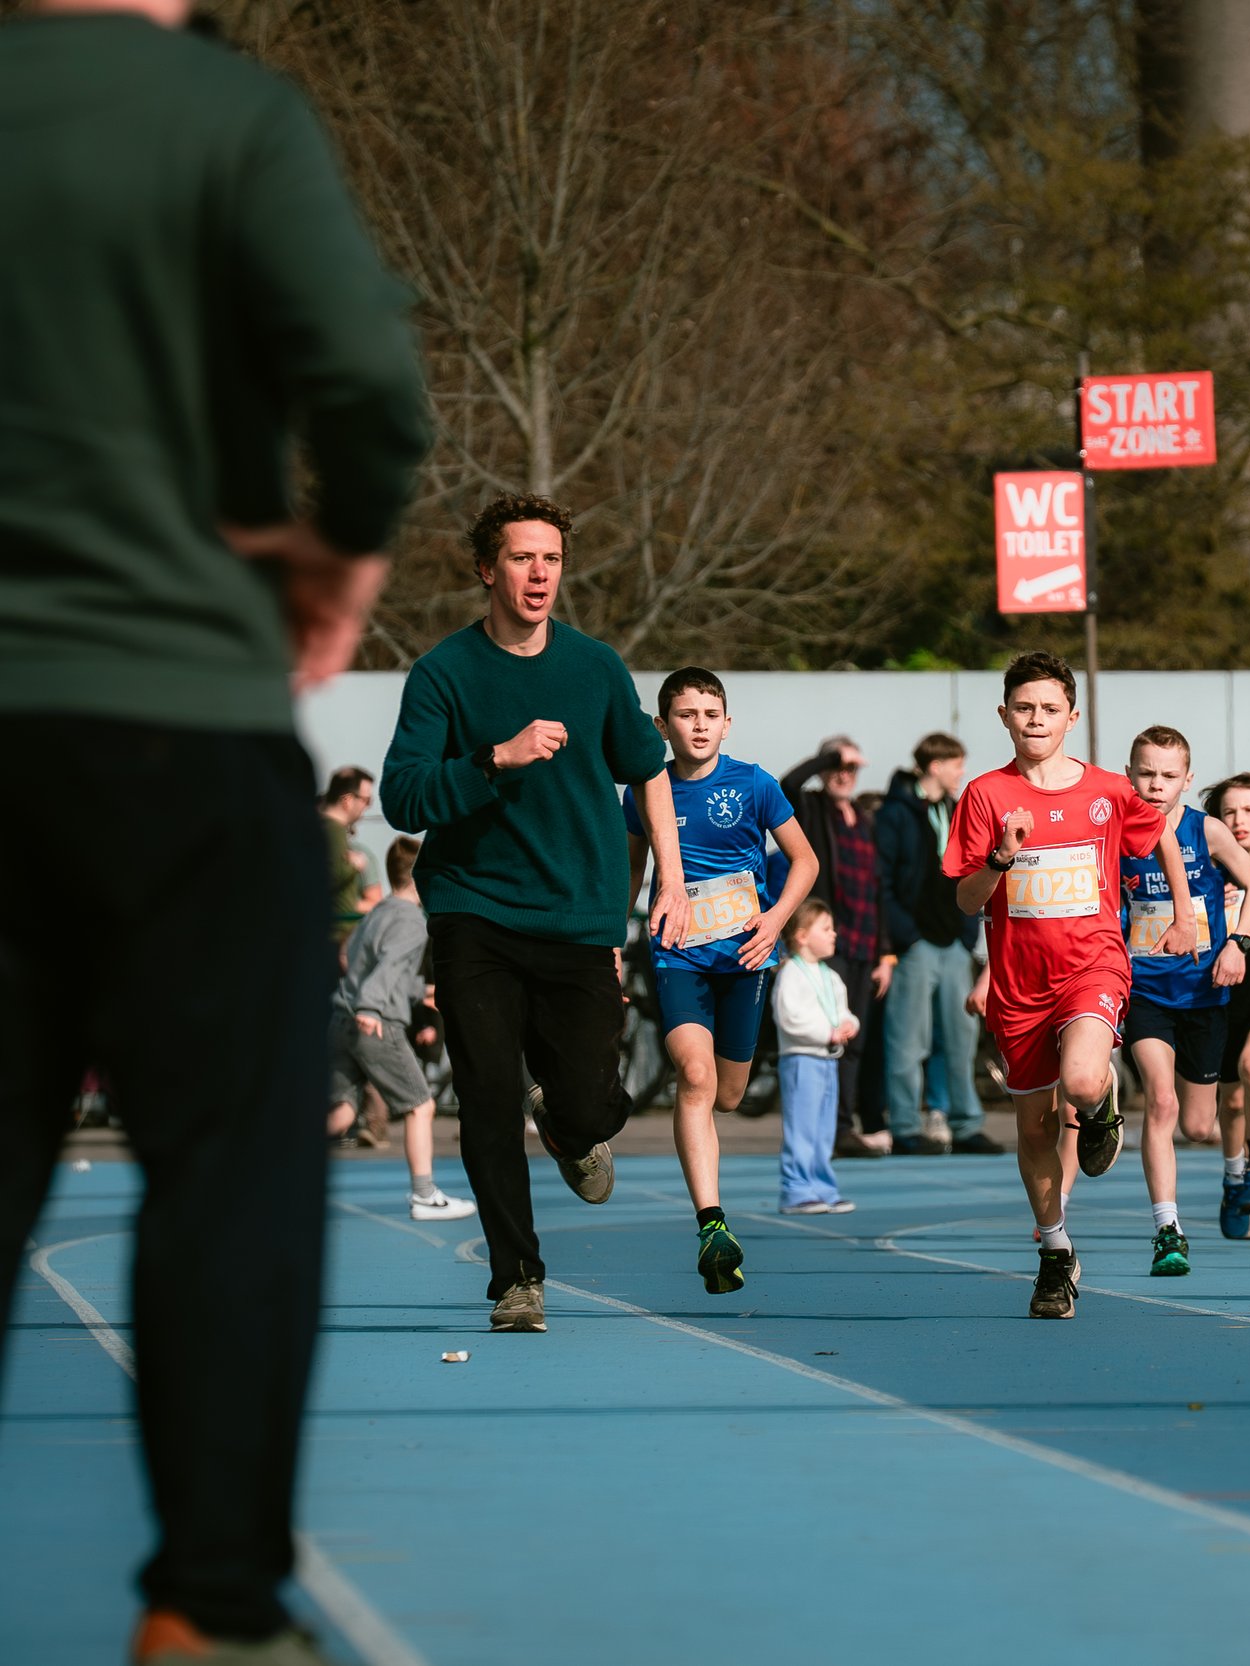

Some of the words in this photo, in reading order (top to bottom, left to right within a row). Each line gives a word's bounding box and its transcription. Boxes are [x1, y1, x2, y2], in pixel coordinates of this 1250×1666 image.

[1087, 380, 1201, 424] START
[1108, 424, 1182, 457] ZONE
[1005, 482, 1079, 528] WC
[1003, 530, 1083, 557] TOILET
[706, 788, 743, 805] VACBL
[1050, 809, 1064, 822] SK
[1069, 851, 1092, 862] KIDS
[726, 877, 750, 887] KIDS
[1010, 868, 1093, 904] 7029
[1146, 882, 1169, 895] lab
